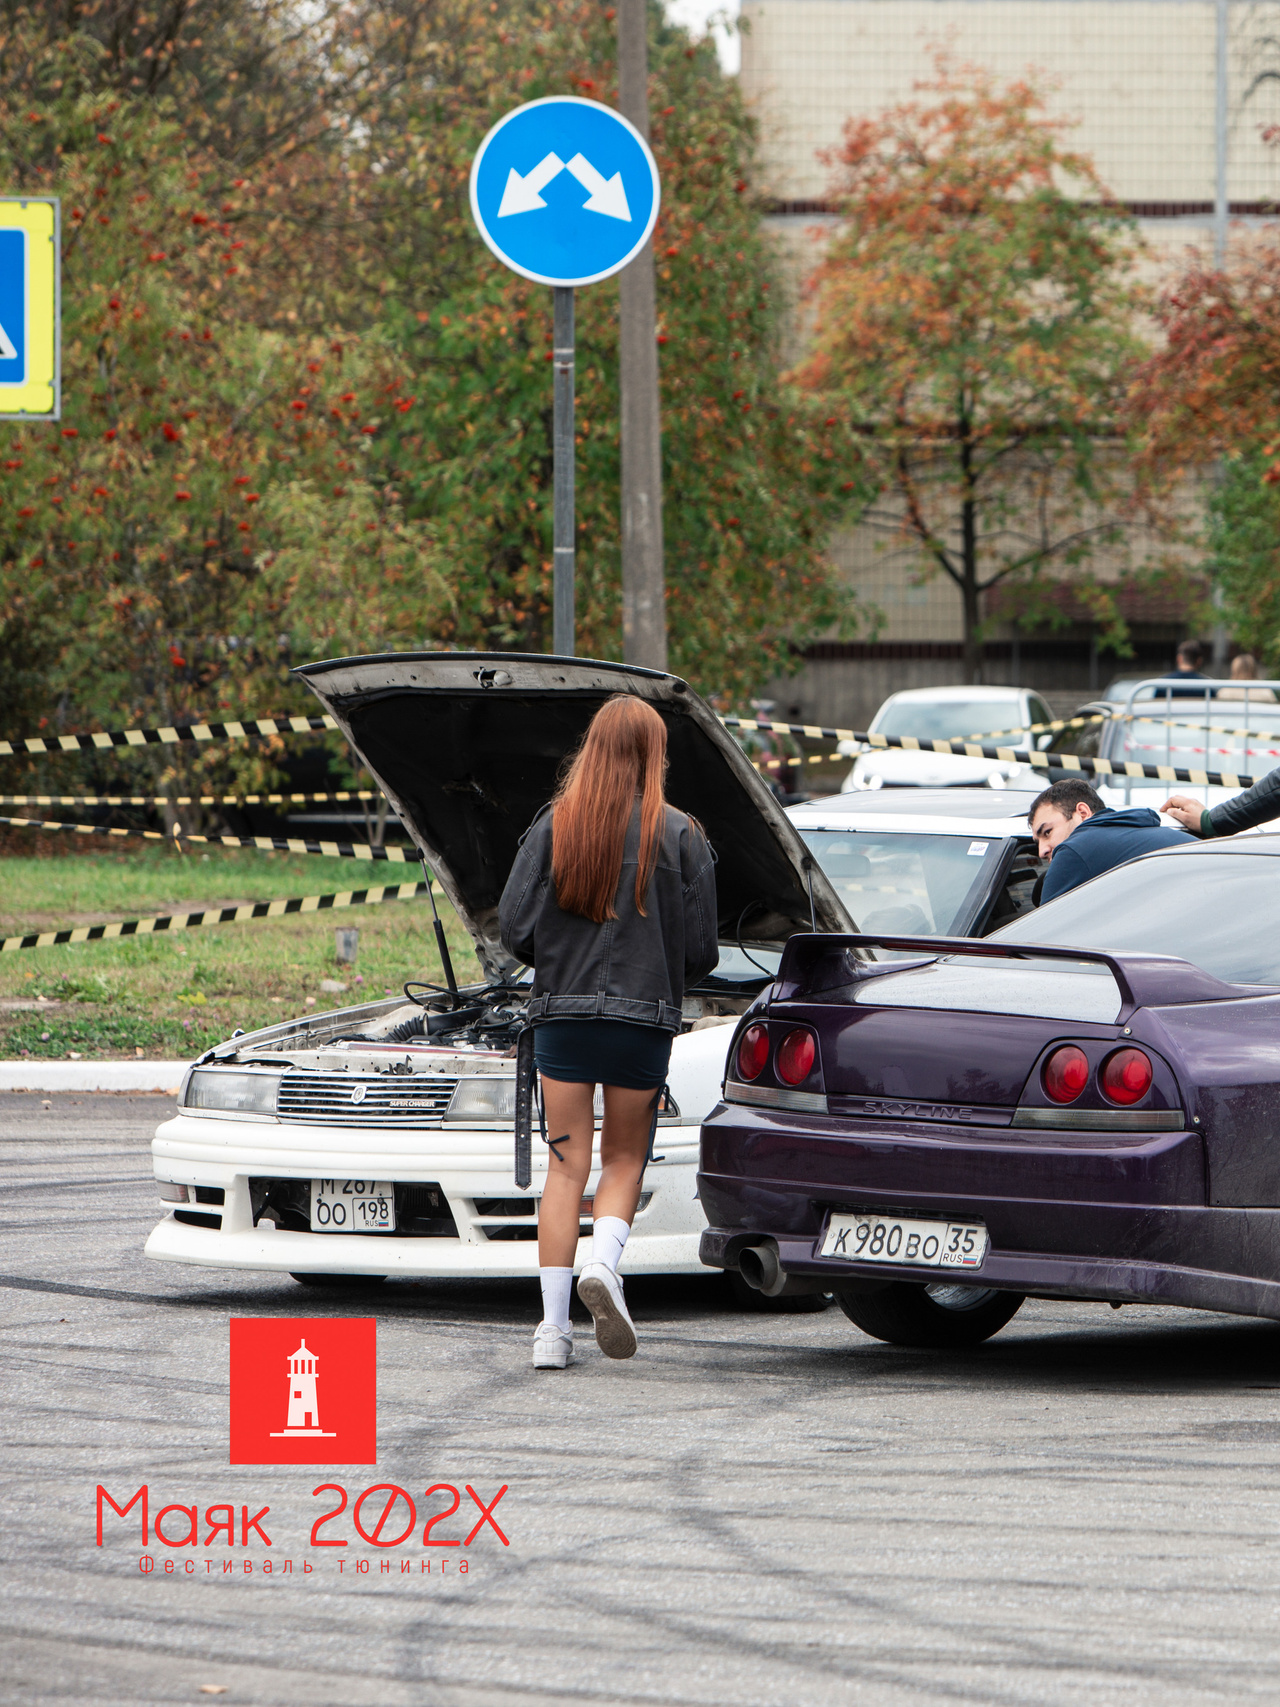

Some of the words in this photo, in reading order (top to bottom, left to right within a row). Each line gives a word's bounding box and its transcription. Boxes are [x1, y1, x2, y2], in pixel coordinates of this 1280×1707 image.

[862, 1101, 973, 1120] SKYLINE
[358, 1201, 389, 1220] 198
[947, 1227, 978, 1254] 35
[942, 1253, 963, 1264] RUS
